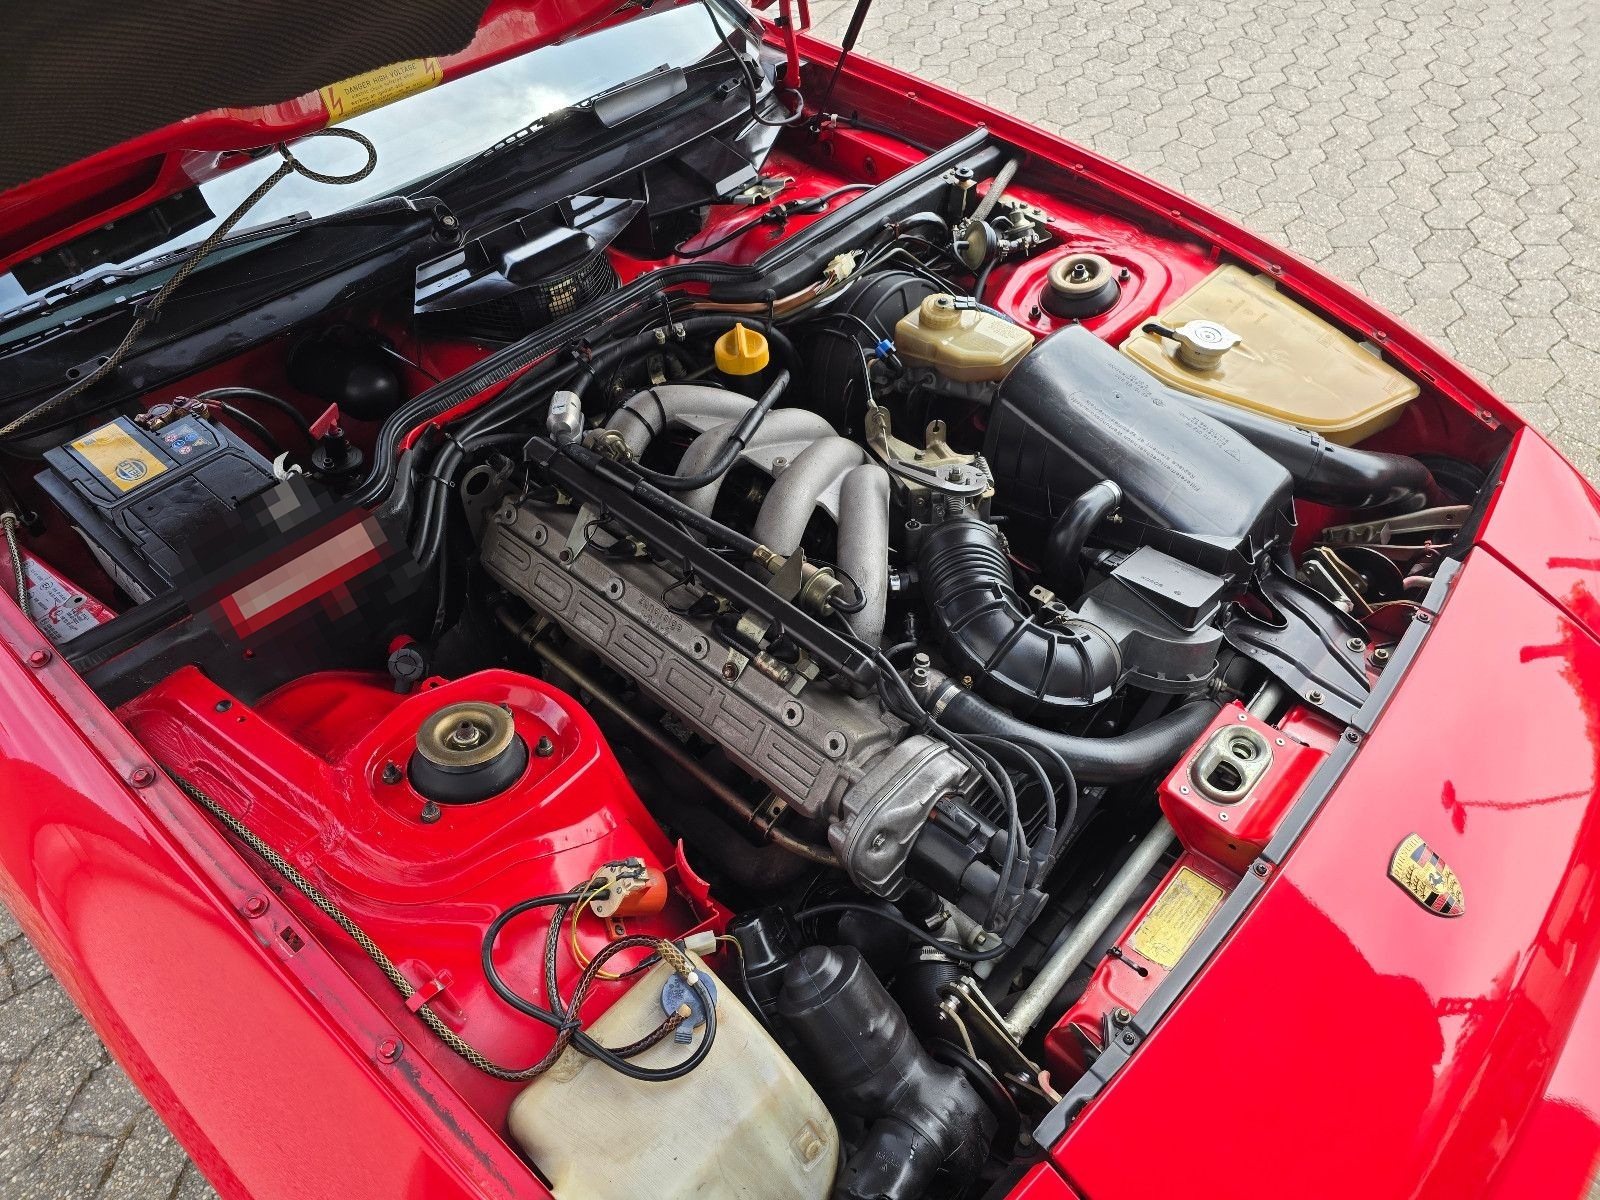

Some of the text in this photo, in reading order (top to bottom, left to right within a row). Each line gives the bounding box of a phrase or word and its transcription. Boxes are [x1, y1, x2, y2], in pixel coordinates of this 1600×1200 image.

[344, 80, 371, 95] DANGER
[372, 74, 388, 84] HIGH
[389, 62, 416, 77] VOLTAGE
[493, 538, 826, 800] PORSCHE
